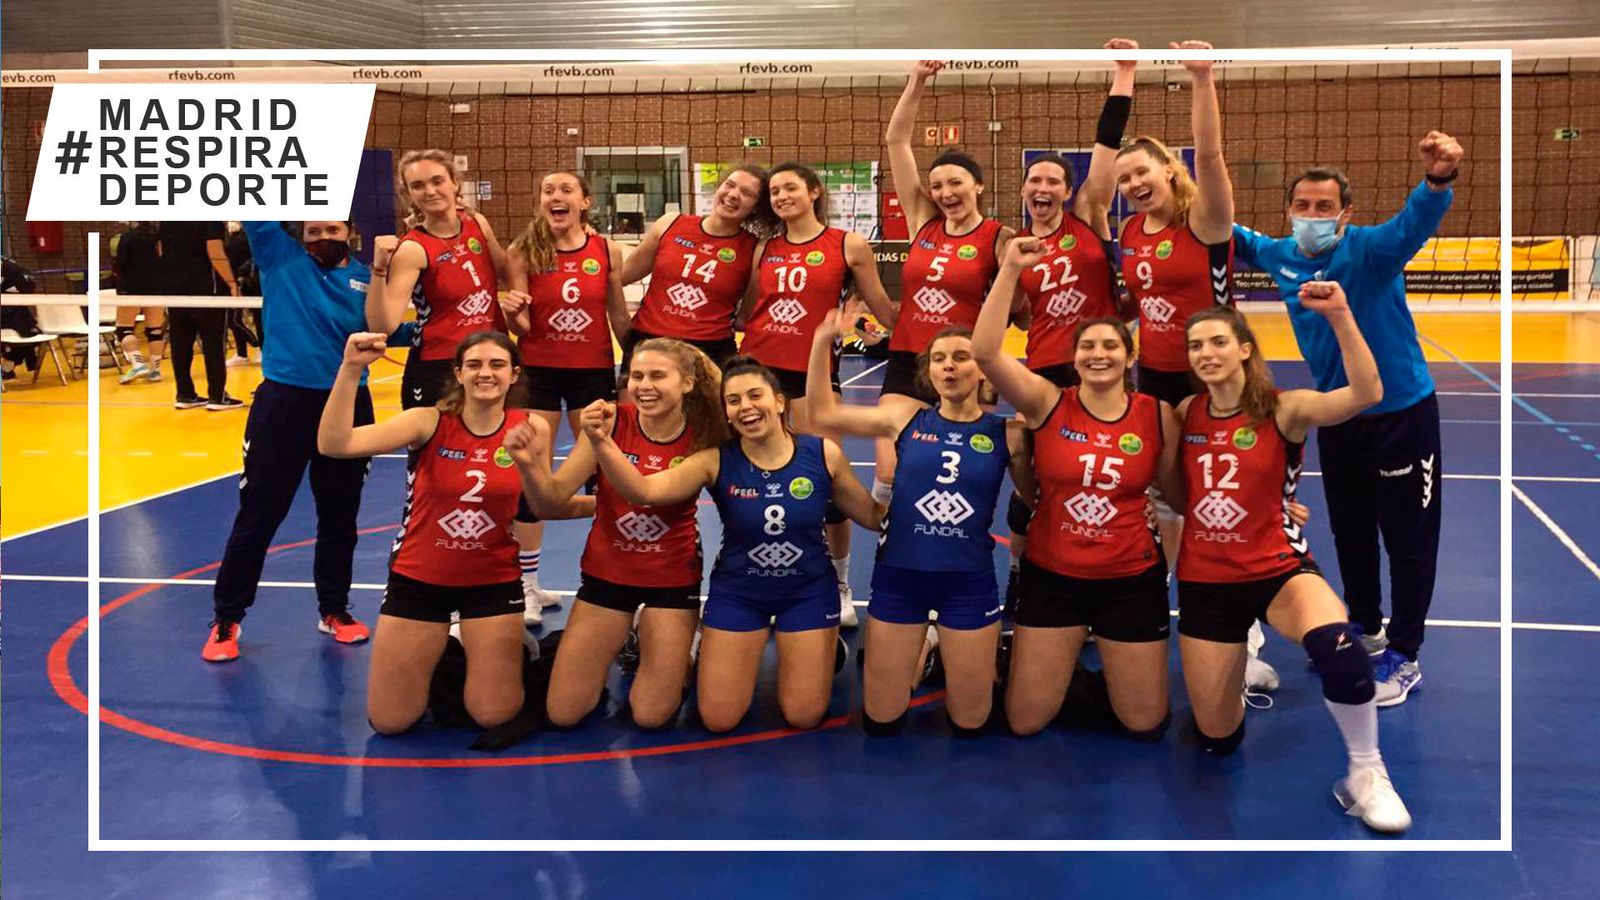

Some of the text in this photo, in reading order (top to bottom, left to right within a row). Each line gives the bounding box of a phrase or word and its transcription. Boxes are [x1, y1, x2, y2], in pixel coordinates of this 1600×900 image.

[168, 71, 235, 82] rfevb.com
[353, 68, 422, 79] rfevb.com
[544, 66, 615, 77] rfevb.com
[739, 62, 813, 74] rfevb.com
[461, 260, 481, 287] 1
[681, 253, 718, 284] 14
[774, 266, 808, 293] 10
[926, 256, 949, 282] 5
[1032, 256, 1079, 292] 22
[1136, 261, 1153, 290] 9
[562, 277, 581, 304] 6
[935, 450, 962, 485] 3
[1078, 453, 1125, 491] 15
[1197, 453, 1240, 490] 12
[460, 469, 487, 503] 2
[763, 504, 787, 536] 8
[914, 524, 970, 539] FUNDAL
[434, 538, 489, 551] FUNDAL
[747, 567, 805, 578] FUNDAL
